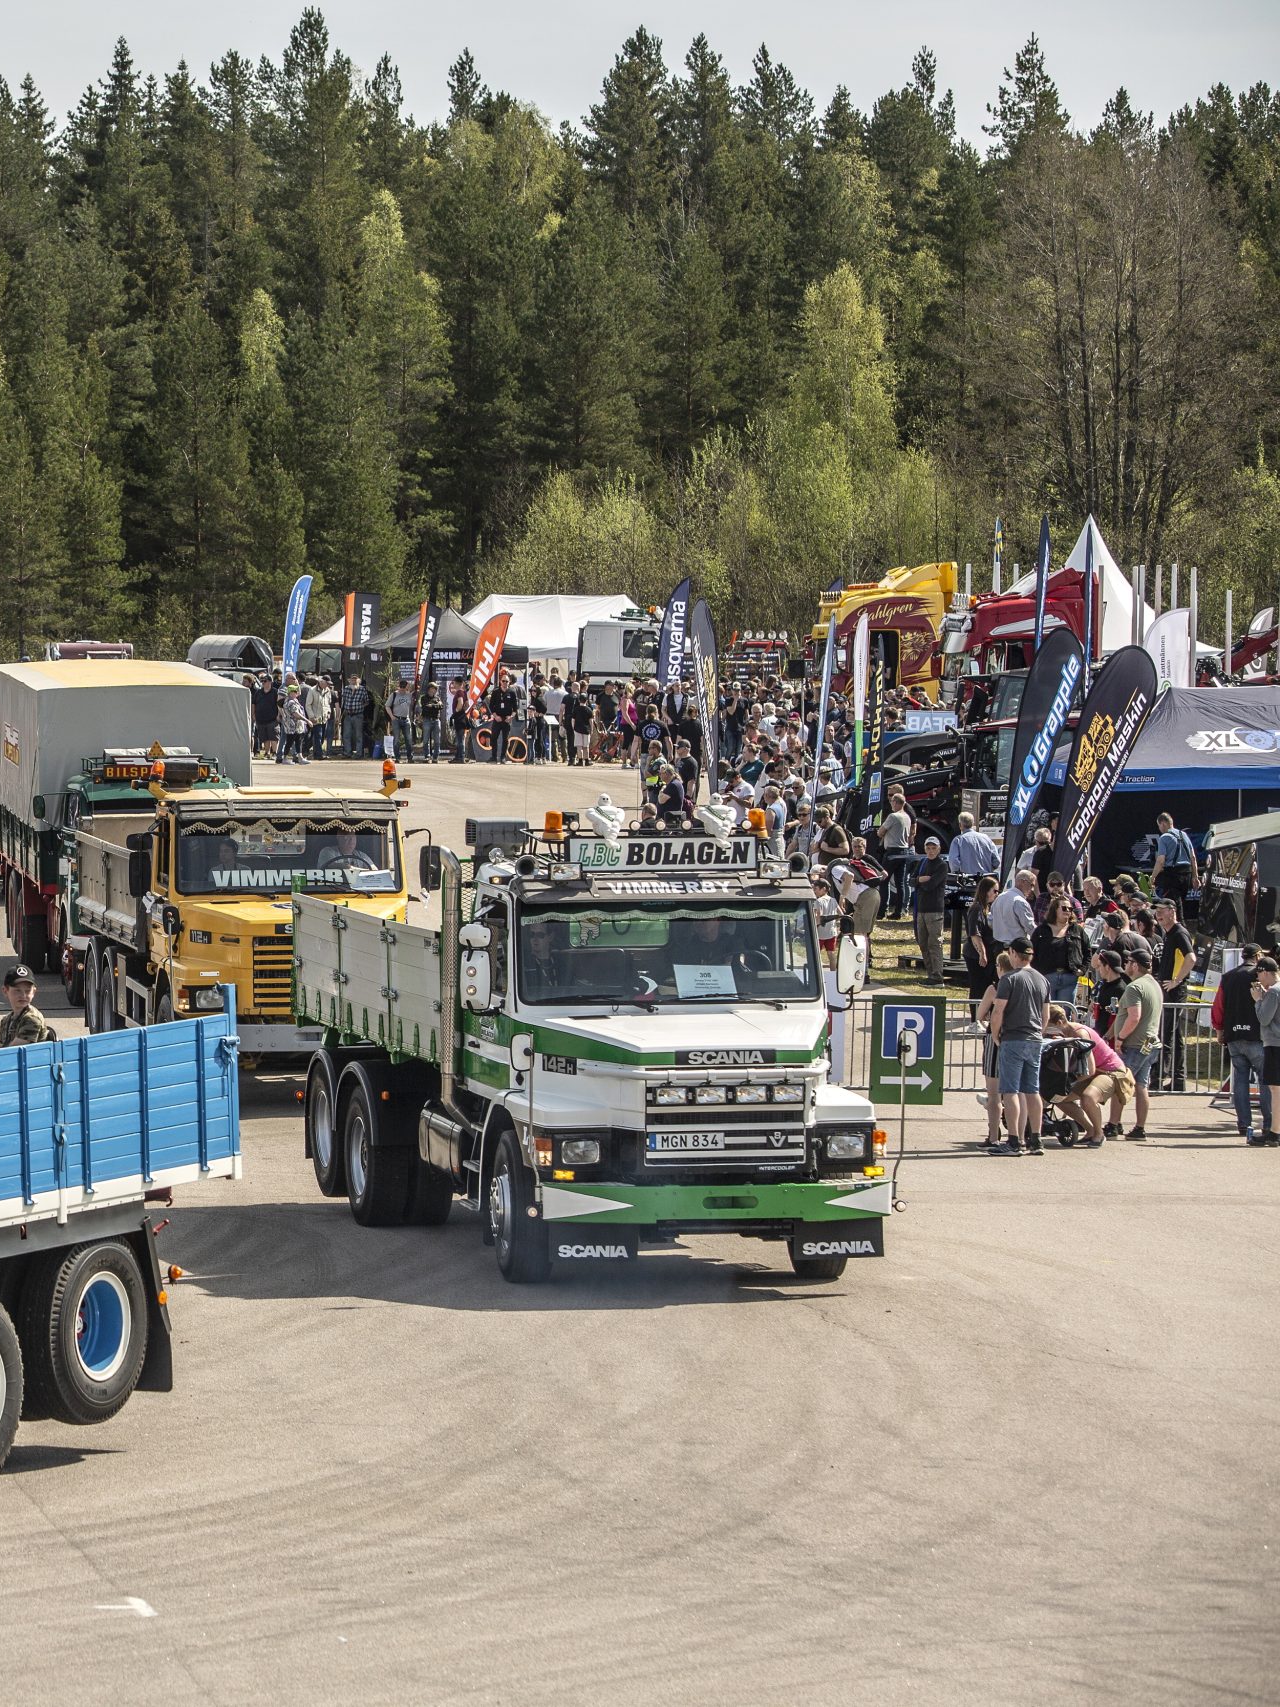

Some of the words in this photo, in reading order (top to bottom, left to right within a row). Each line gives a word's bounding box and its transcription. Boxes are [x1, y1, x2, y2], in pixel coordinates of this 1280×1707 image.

[1033, 655, 1080, 762] Grapple
[1203, 733, 1240, 748] XL
[1067, 765, 1111, 850] Koppom
[1106, 692, 1147, 768] Maskin
[1124, 775, 1156, 783] Traction
[1097, 786, 1112, 812] FOREST
[578, 842, 621, 867] LBC
[625, 841, 751, 866] BOLAGEN
[607, 880, 731, 895] VIMMERBY
[897, 1011, 925, 1047] P
[688, 1050, 765, 1065] SCANIA
[661, 1134, 688, 1148] MGN
[692, 1134, 719, 1148] 834
[557, 1244, 629, 1258] SCANIA
[802, 1240, 876, 1255] SCANIA
